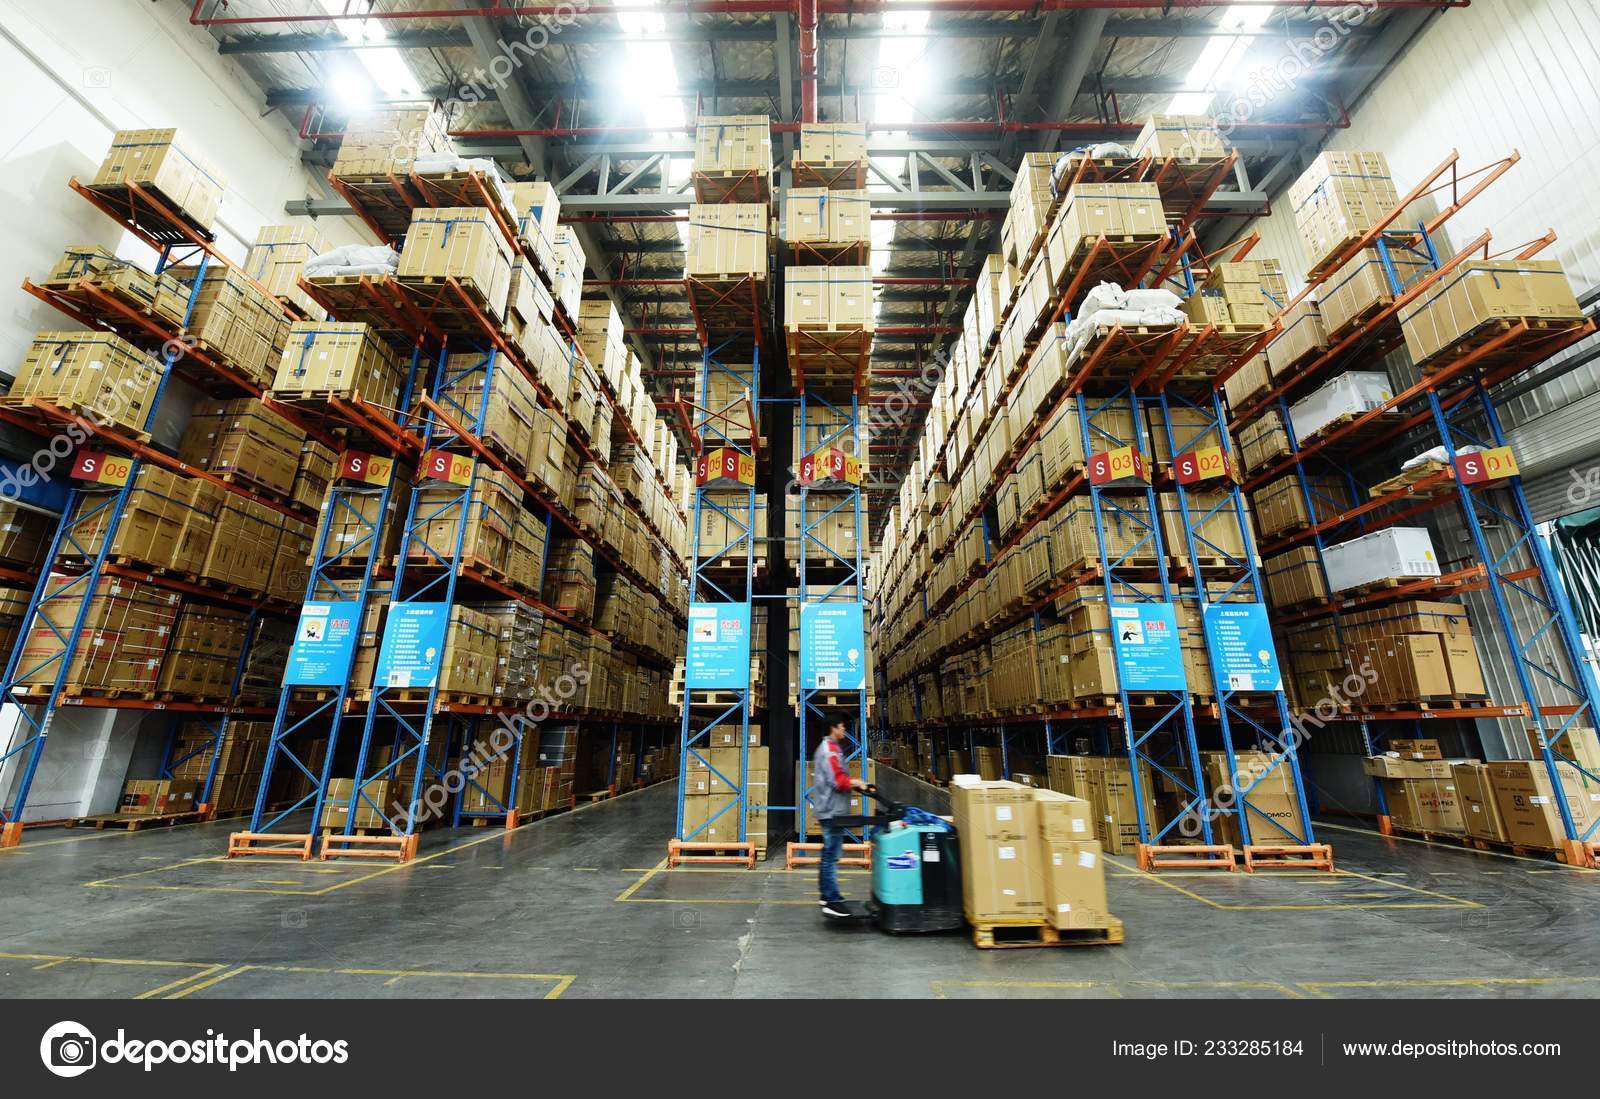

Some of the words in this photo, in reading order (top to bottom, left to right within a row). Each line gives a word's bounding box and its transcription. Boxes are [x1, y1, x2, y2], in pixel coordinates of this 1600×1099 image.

[81, 458, 96, 473] S
[104, 463, 128, 479] 08
[350, 458, 362, 473] S
[369, 462, 390, 478] 07
[434, 457, 446, 473] S
[452, 462, 471, 479] 06
[699, 463, 706, 477] S
[709, 456, 721, 473] 05
[726, 457, 735, 472] S
[740, 462, 754, 478] 05
[804, 462, 811, 476] S
[815, 456, 830, 472] 04
[834, 456, 842, 471] S
[846, 462, 859, 476] 04
[1095, 461, 1106, 476] S
[1112, 455, 1132, 471] 03
[1182, 461, 1193, 476] S
[1200, 454, 1220, 471] 02
[1465, 461, 1479, 475] S
[1487, 453, 1513, 471] 01
